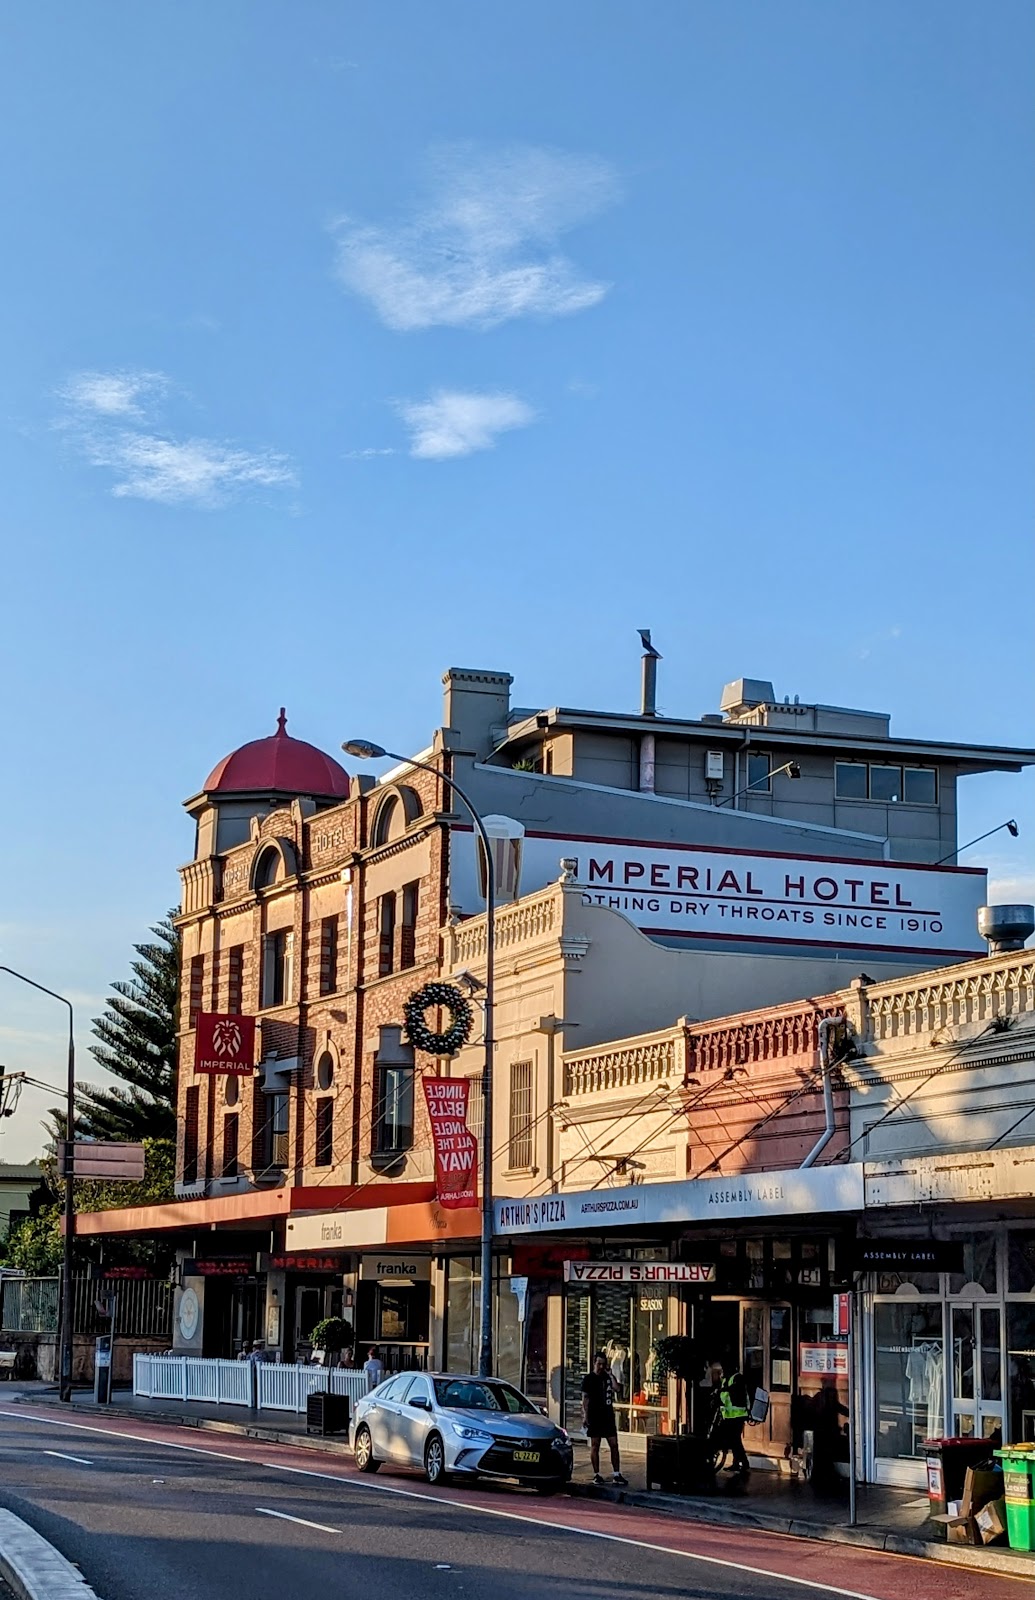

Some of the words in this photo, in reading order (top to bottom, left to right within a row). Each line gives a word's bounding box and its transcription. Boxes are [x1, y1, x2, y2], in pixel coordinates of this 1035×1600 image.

[315, 827, 347, 852] HOTEL
[785, 874, 912, 907] HOTEL
[670, 900, 710, 916] DRY
[717, 904, 815, 924] THROATS
[823, 912, 887, 929] SINCE
[900, 918, 943, 933] 1910
[200, 1060, 251, 1071] IMPERIAL
[708, 1189, 753, 1205] ASSEMBLY
[757, 1187, 784, 1201] LABEL
[500, 1202, 539, 1227] ARTHUR'S
[541, 1200, 566, 1224] PIZZA
[580, 1199, 639, 1214] ARTHURSPIZZA.COM.AU
[320, 1223, 342, 1241] franka
[863, 1252, 907, 1260] ASSEMBLY
[911, 1253, 936, 1261] LABEL
[376, 1262, 417, 1275] franka
[573, 1265, 624, 1281] PIZZA
[630, 1263, 713, 1281] ARTHUR'S
[640, 1299, 664, 1311] SEASON
[643, 1382, 660, 1396] SALE
